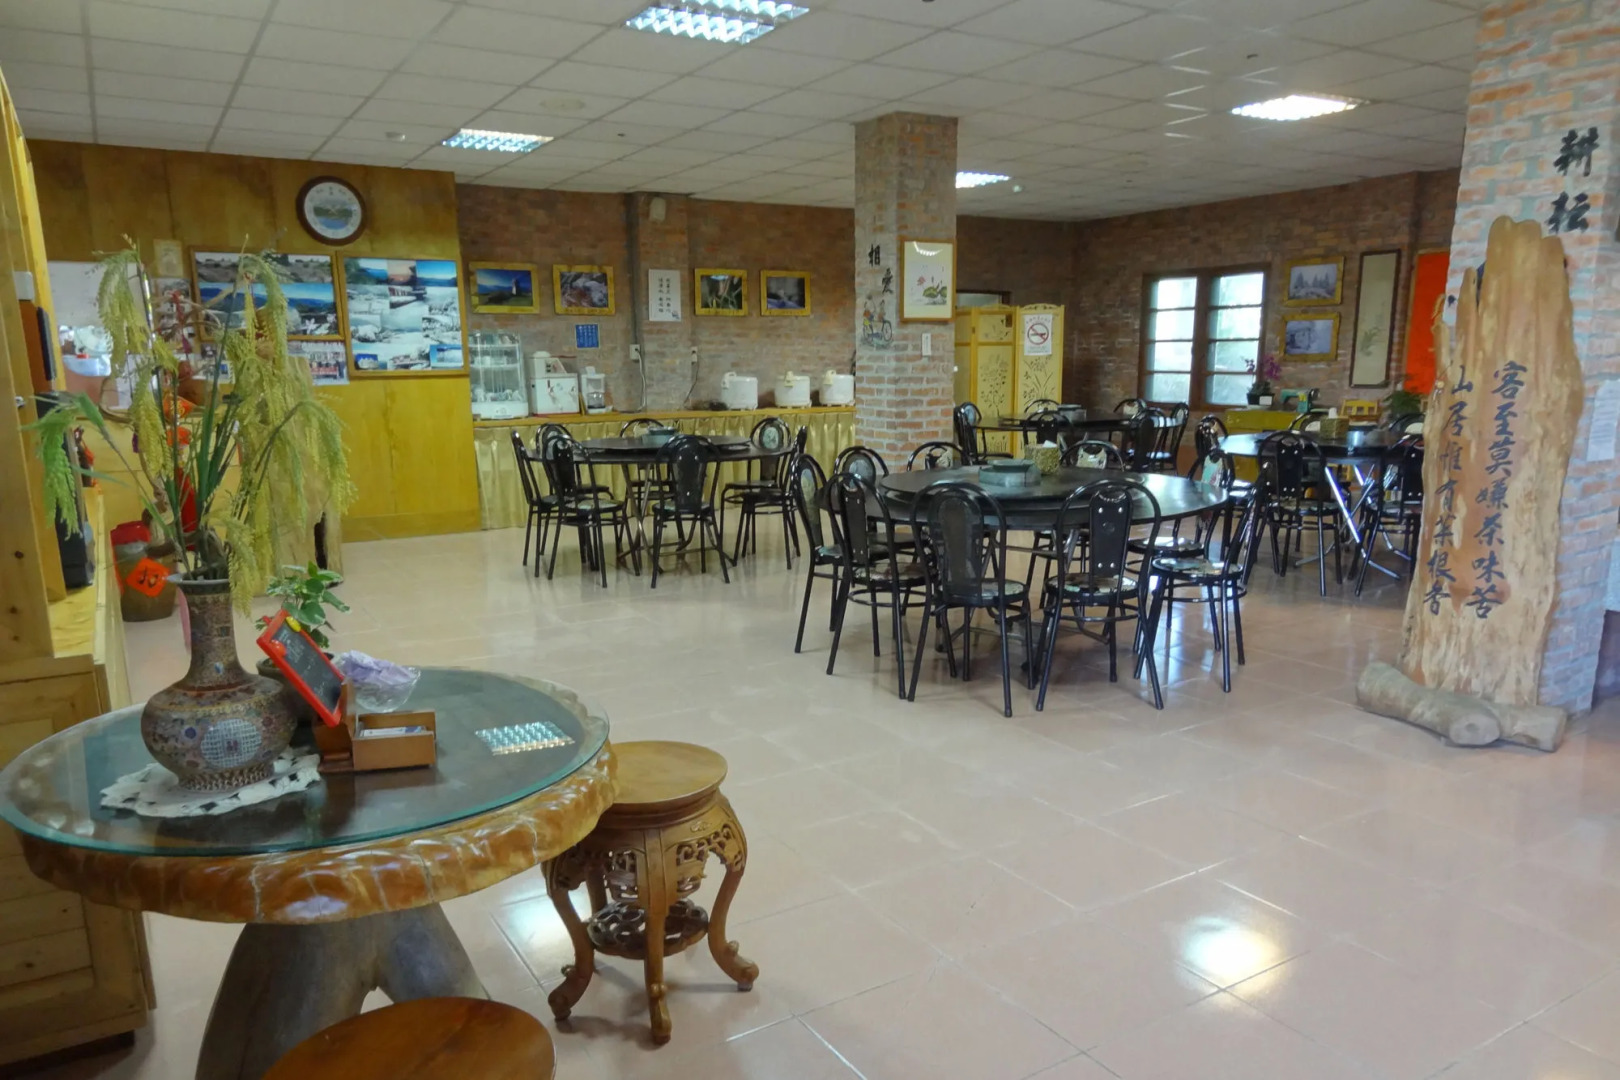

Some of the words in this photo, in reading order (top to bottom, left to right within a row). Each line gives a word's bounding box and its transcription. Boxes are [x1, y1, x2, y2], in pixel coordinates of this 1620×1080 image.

[1465, 360, 1528, 619] 客至莫嫌茶味苦
